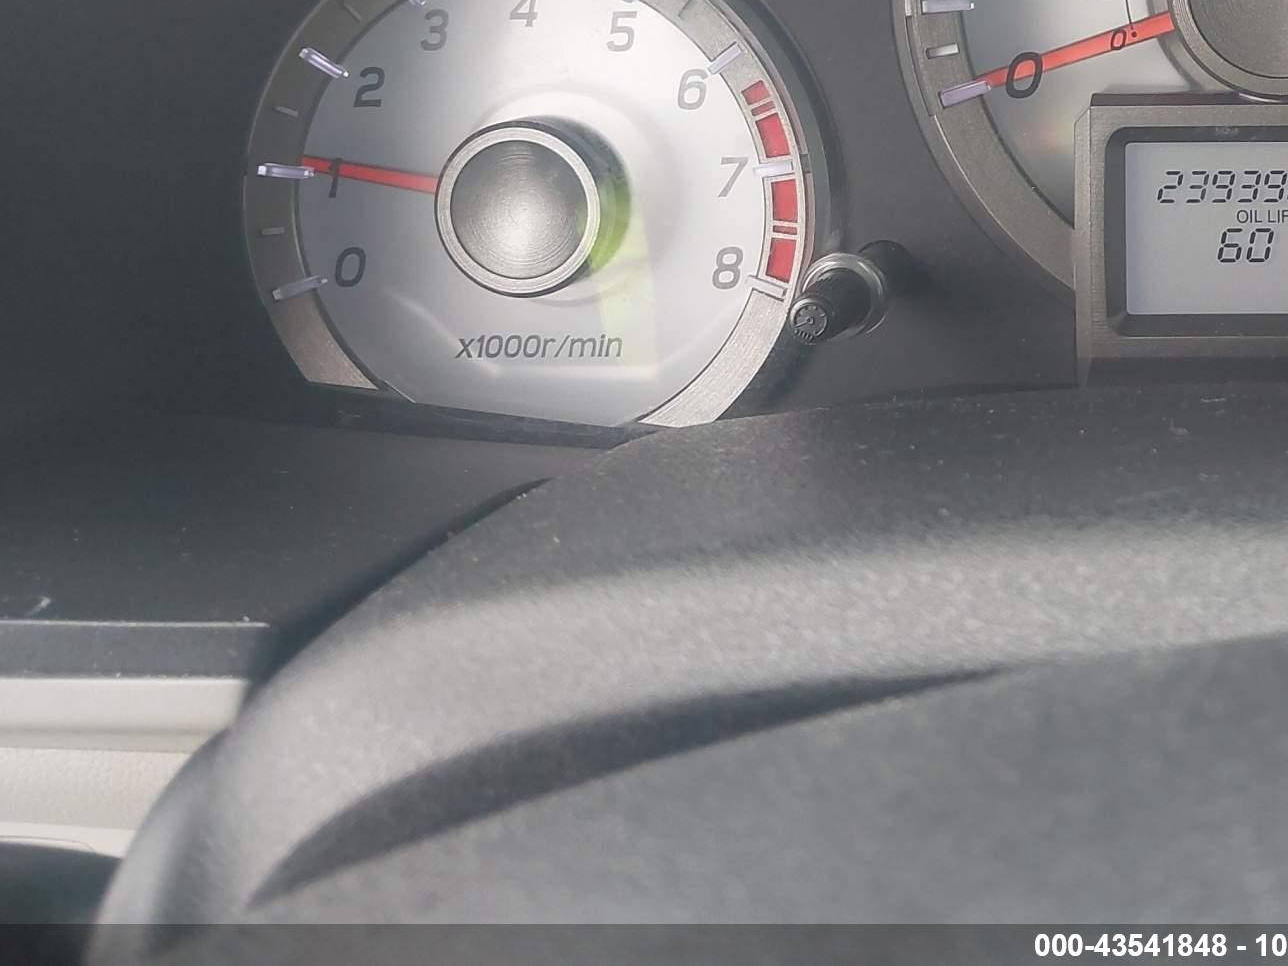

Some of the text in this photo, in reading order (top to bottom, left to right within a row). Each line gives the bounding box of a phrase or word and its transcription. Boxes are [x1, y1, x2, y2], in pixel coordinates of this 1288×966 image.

[420, 9, 450, 51] 3
[606, 10, 637, 52] 5
[1110, 28, 1127, 50] 0
[353, 67, 386, 108] 2
[676, 68, 708, 111] 6
[1006, 51, 1043, 98] 0
[328, 157, 342, 198] 1
[717, 156, 750, 198] 7
[1236, 209, 1263, 224] OIL
[335, 245, 366, 288] 0
[1217, 228, 1274, 263] 60
[711, 246, 744, 289] 8
[455, 333, 623, 360] x1000r/min
